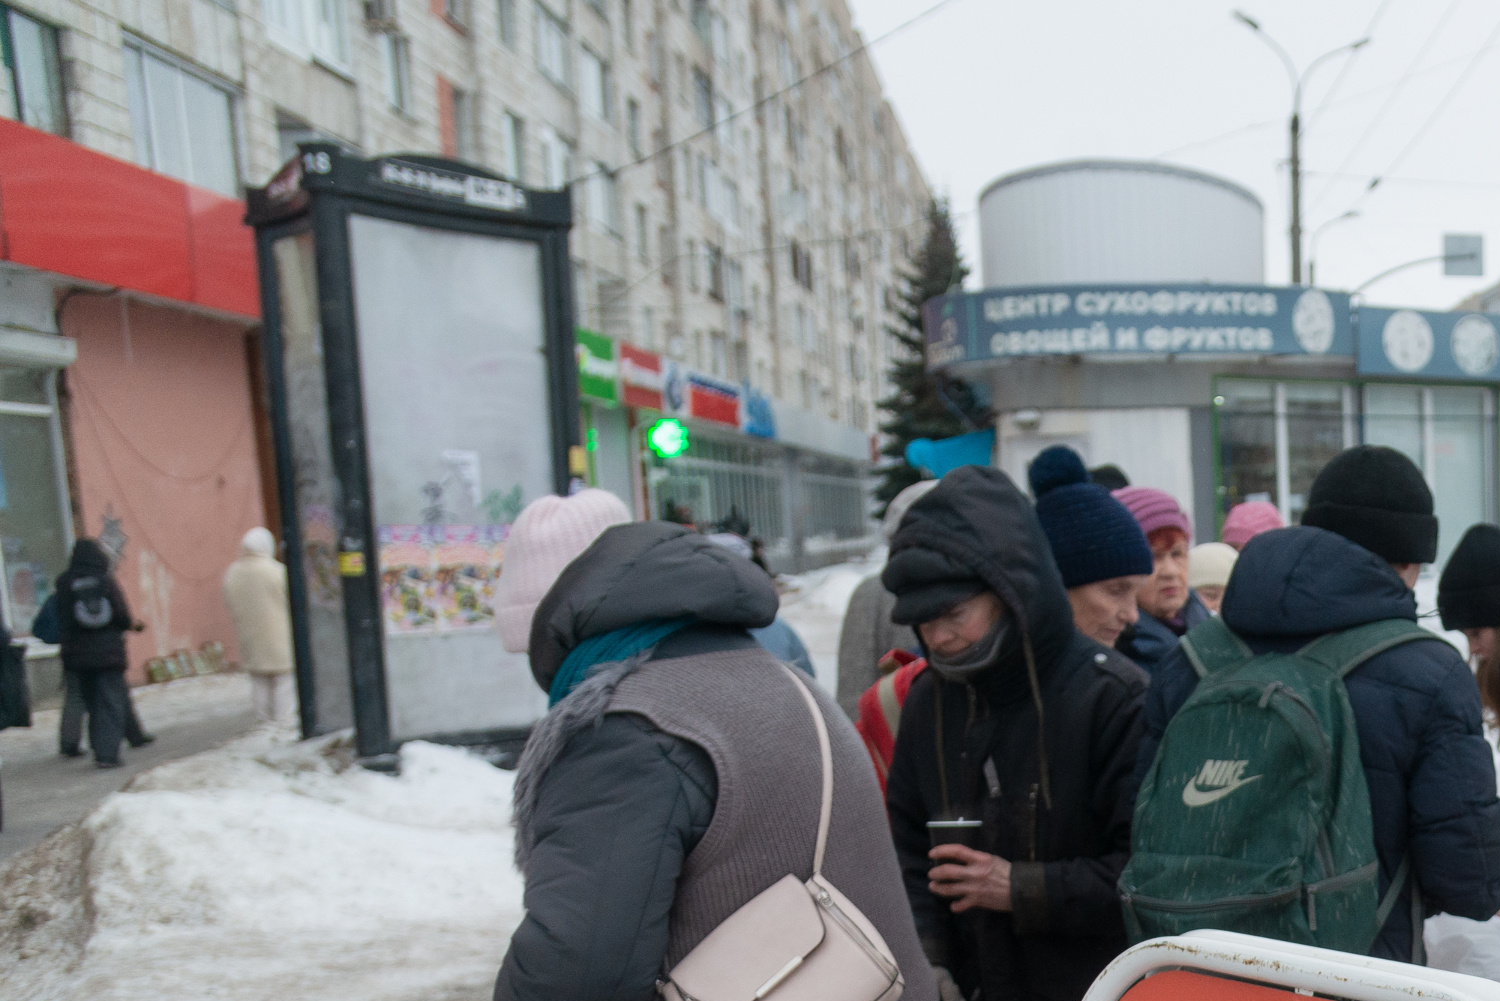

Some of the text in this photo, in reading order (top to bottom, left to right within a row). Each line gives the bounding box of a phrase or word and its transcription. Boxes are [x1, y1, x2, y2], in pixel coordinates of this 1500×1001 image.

[983, 290, 1278, 323] ЦЕНТР СУХОФРУКТОВ
[990, 321, 1110, 355] ОВОЩЕЙ
[1115, 327, 1139, 350] И
[1143, 325, 1274, 351] ФРУКТОВ
[1196, 759, 1249, 786] NIKE
